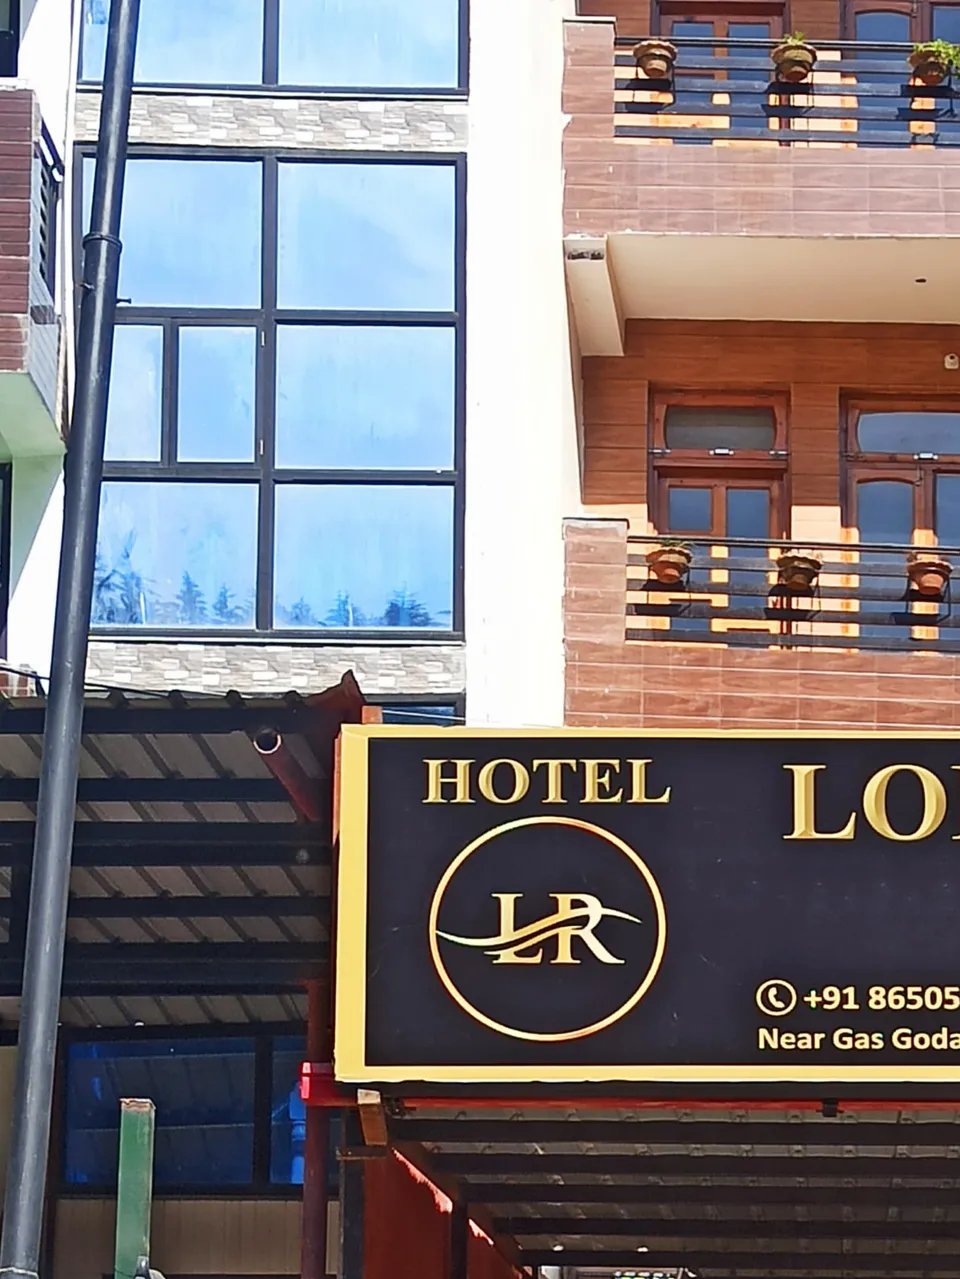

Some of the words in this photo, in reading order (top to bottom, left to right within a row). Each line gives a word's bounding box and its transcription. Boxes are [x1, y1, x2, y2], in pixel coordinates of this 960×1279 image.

[422, 758, 671, 804] HOTEL
[803, 986, 860, 1010] +91
[758, 1027, 826, 1050] Near
[832, 1027, 885, 1050] Gas
